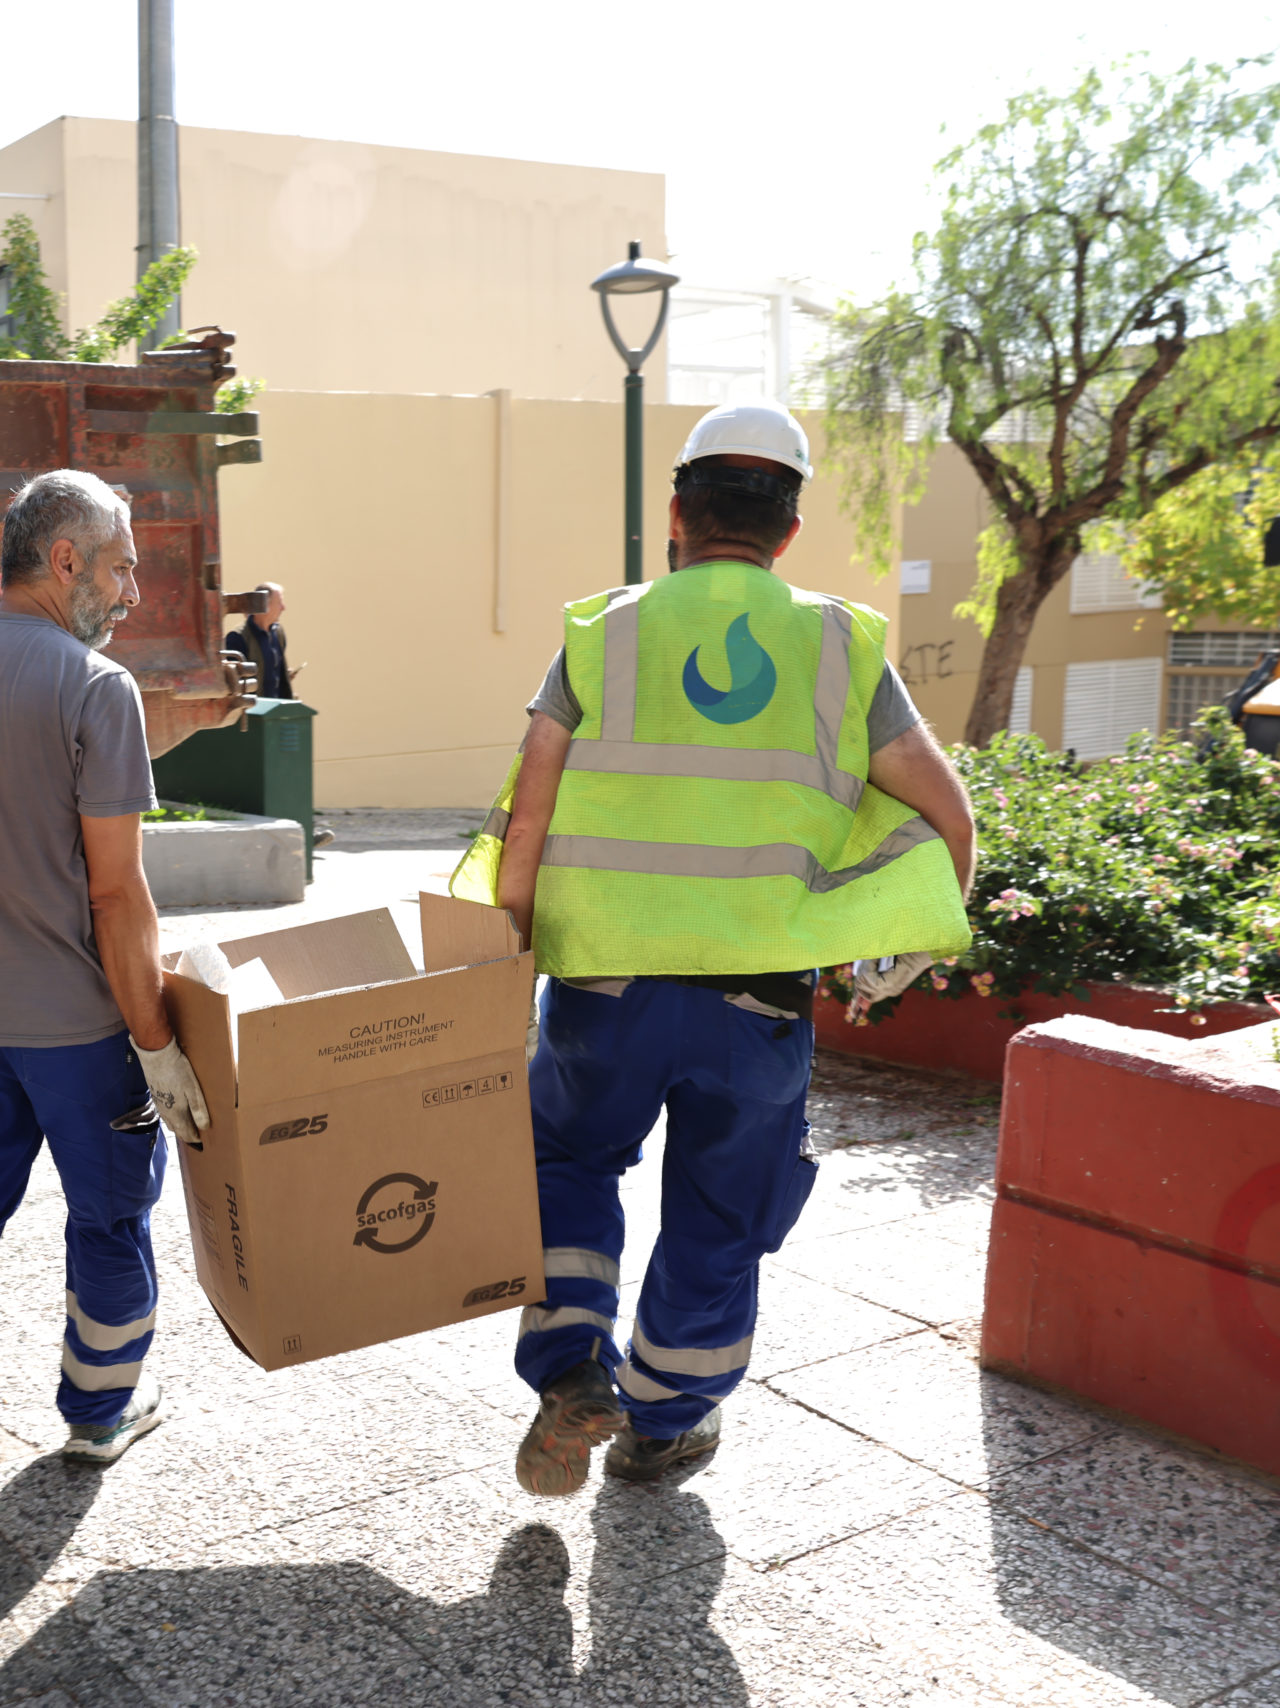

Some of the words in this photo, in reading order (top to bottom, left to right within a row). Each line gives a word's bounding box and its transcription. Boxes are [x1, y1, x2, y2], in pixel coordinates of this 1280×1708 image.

[318, 1037, 383, 1057] MEASURING
[385, 1020, 455, 1042] INSTRUMENT
[350, 1012, 425, 1039] CAUTION!
[333, 1047, 377, 1064] HANDLE
[379, 1040, 407, 1053] WITH
[409, 1033, 439, 1047] CARE
[356, 1199, 436, 1228] sacofgas
[225, 1182, 249, 1291] FRAGILE
